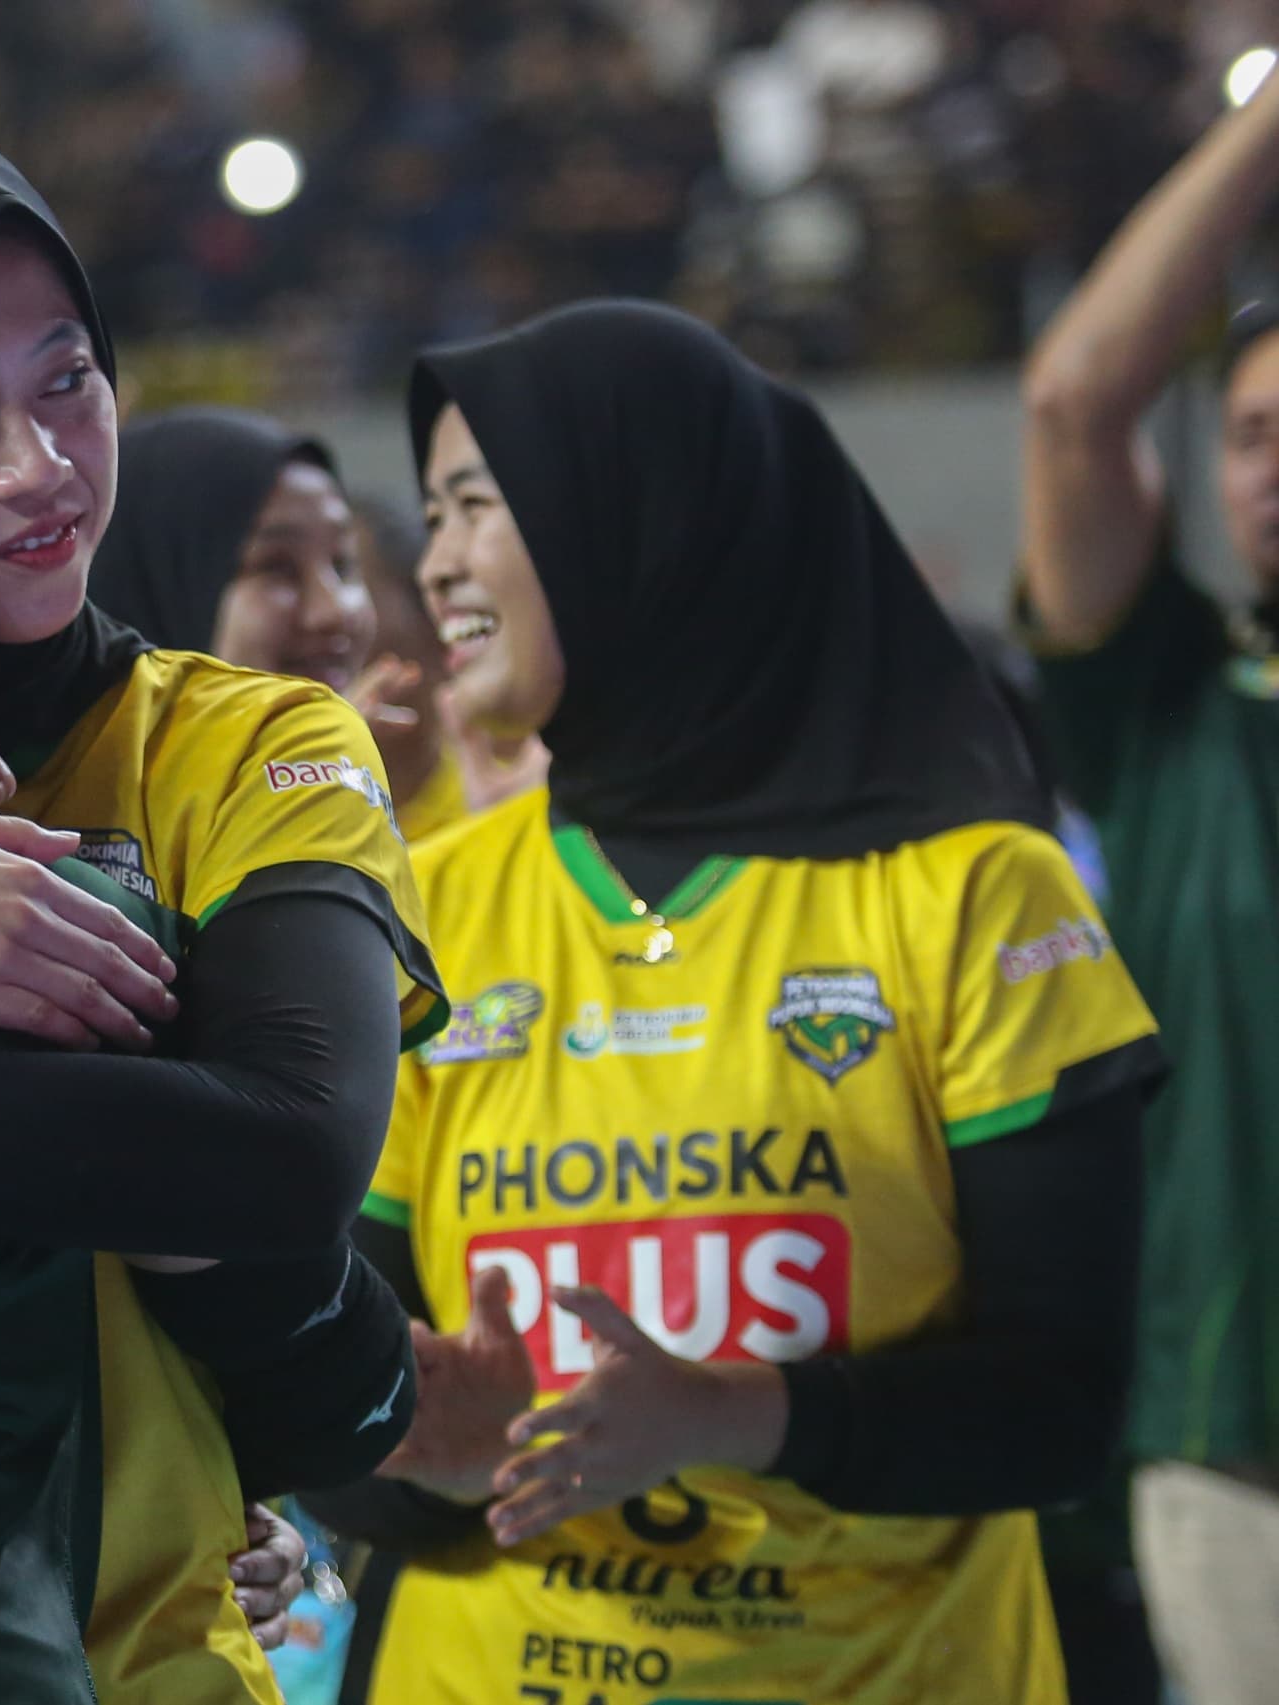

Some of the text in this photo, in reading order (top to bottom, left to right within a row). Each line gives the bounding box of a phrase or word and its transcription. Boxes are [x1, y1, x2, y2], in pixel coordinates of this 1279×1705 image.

[77, 841, 139, 868] OKIMIA
[100, 863, 155, 901] ONESIA
[459, 1126, 848, 1216] PHONSKA
[469, 1228, 830, 1374] PLUS
[522, 1632, 671, 1687] PETRO
